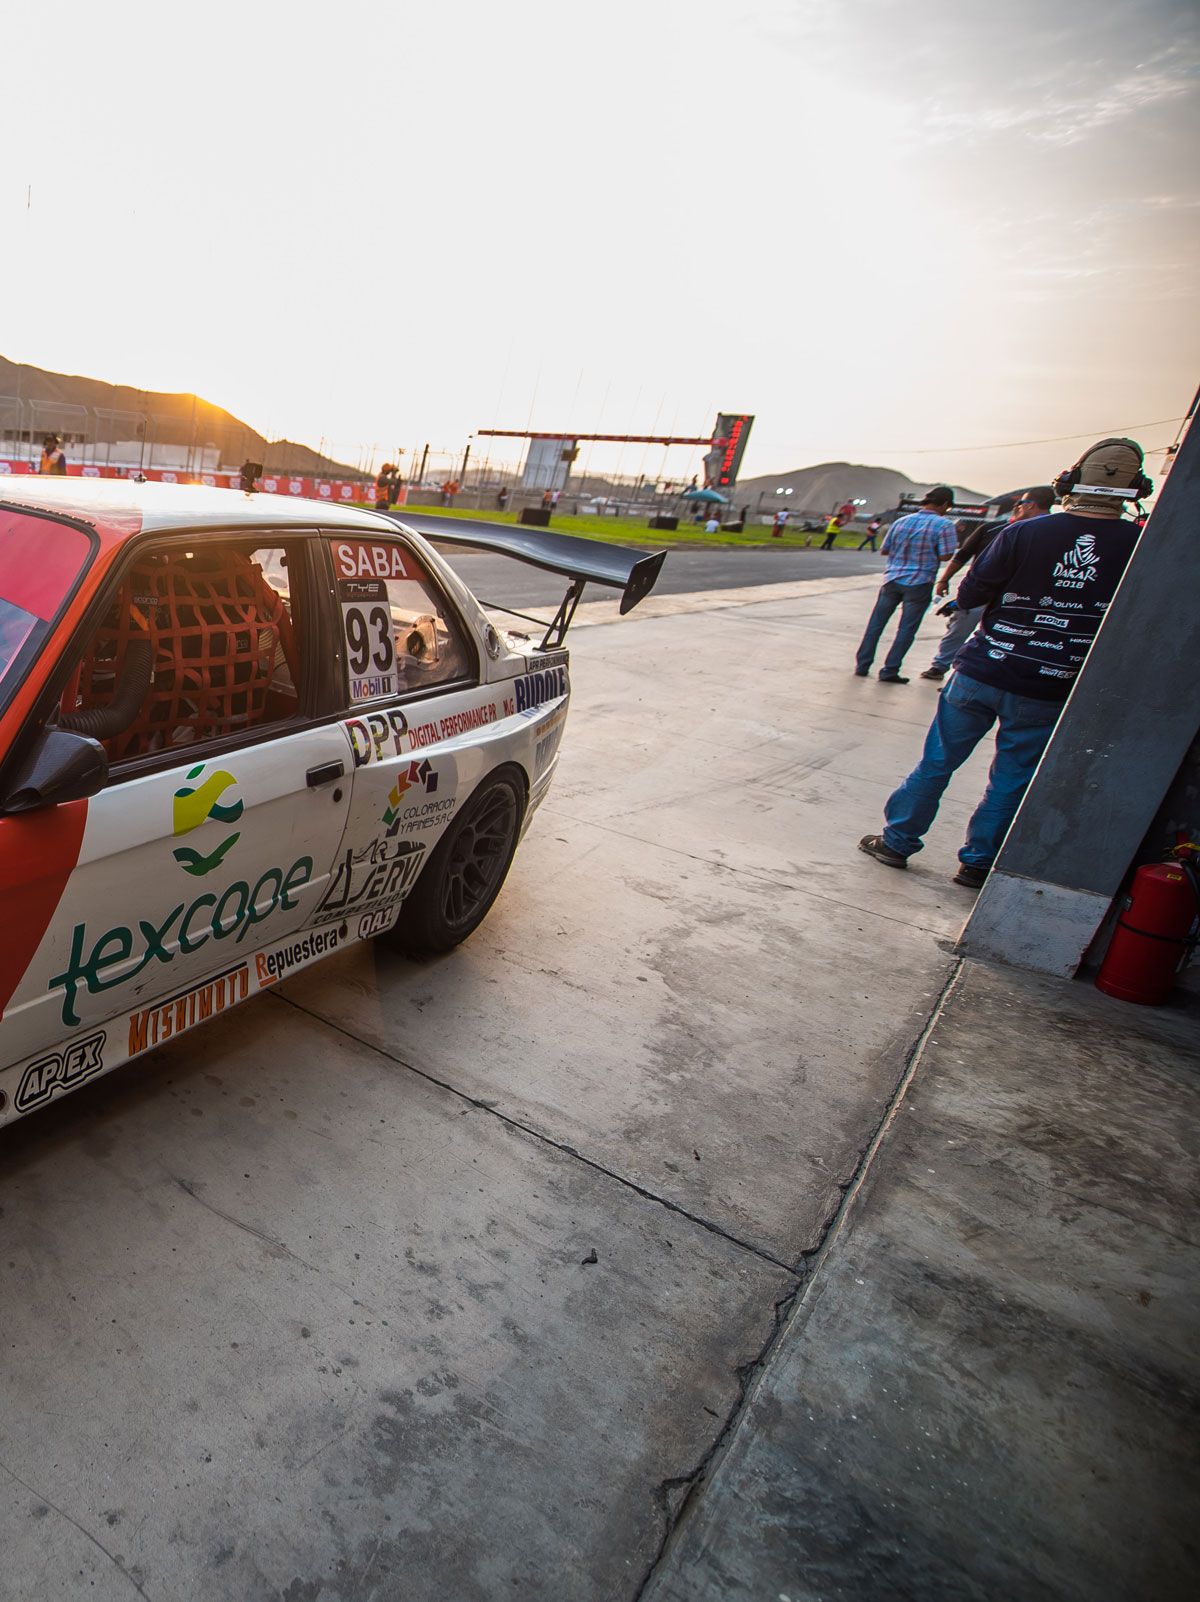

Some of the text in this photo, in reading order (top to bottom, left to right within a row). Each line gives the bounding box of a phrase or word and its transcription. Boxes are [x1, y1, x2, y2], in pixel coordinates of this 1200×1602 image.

[337, 544, 408, 578] SABA
[1052, 563, 1098, 582] DAKAR
[347, 583, 379, 593] TYE
[1055, 579, 1086, 590] 2018
[345, 606, 393, 675] 93
[353, 680, 381, 698] Mobil
[345, 709, 409, 768] DPP
[408, 721, 442, 750] DIGITAL
[440, 705, 489, 739] PERFORMANCE
[358, 905, 394, 939] QA1
[48, 855, 313, 1027] texcope
[255, 927, 339, 987] Repuestera
